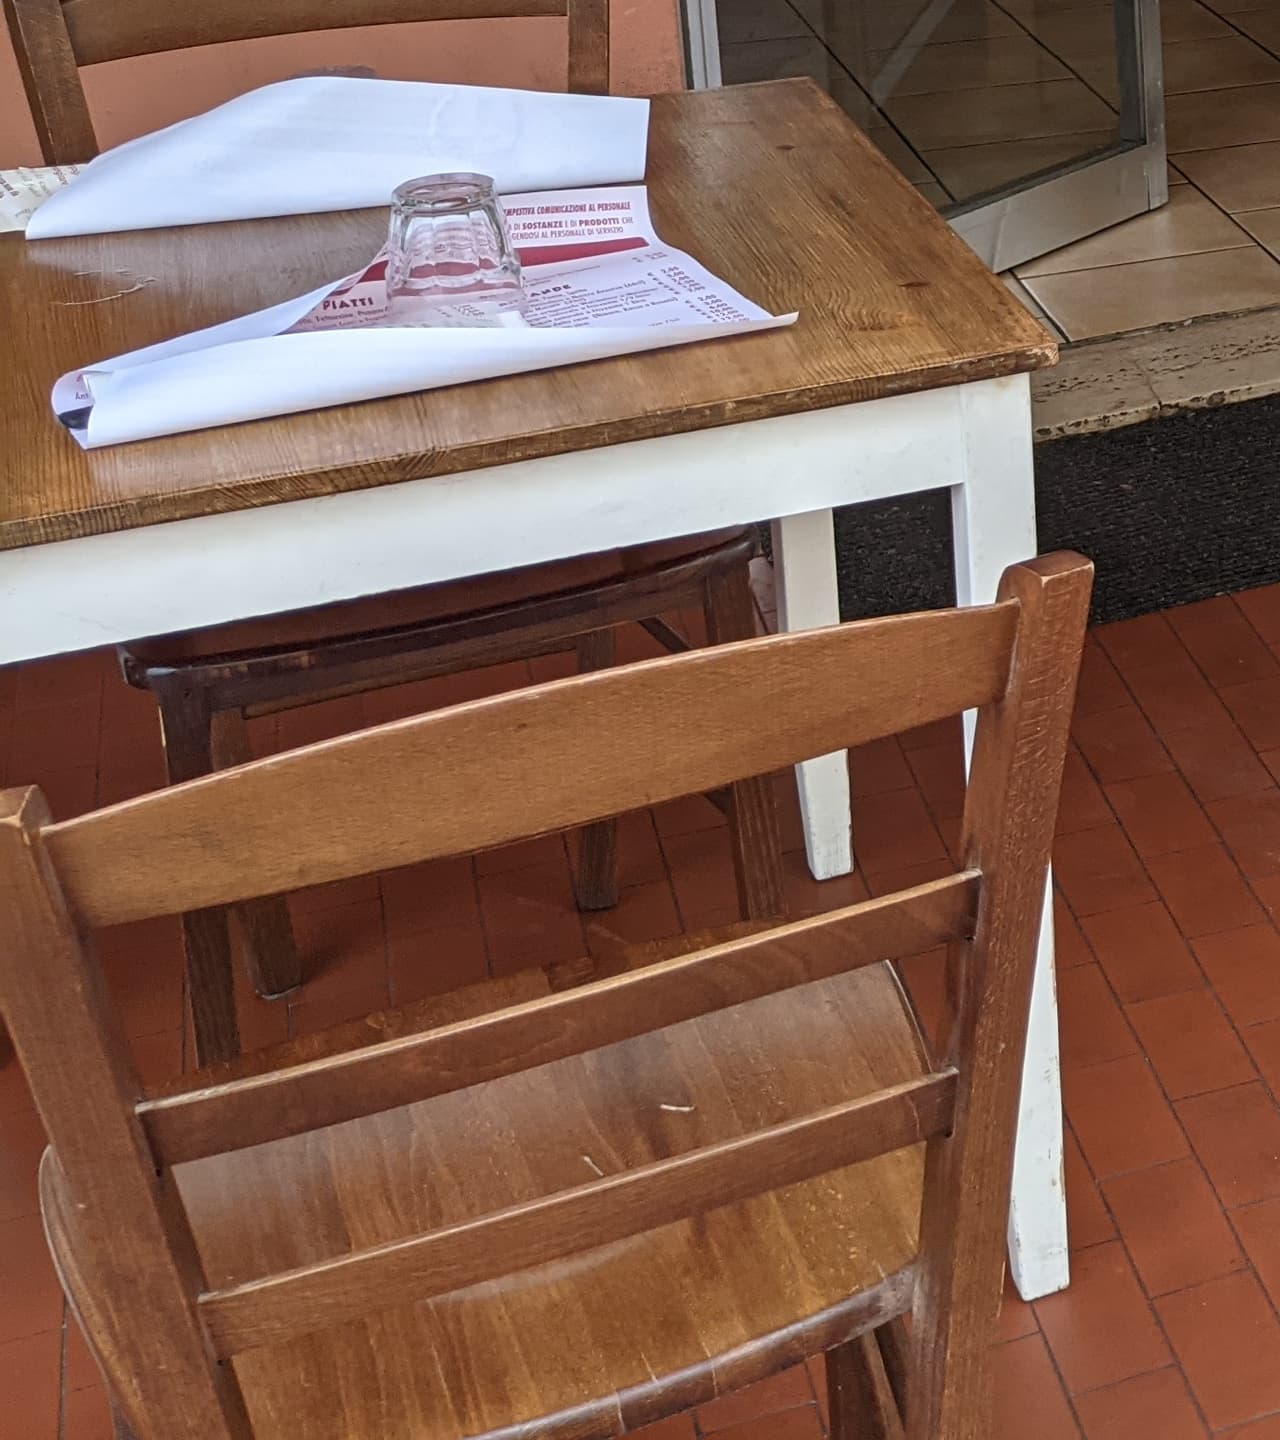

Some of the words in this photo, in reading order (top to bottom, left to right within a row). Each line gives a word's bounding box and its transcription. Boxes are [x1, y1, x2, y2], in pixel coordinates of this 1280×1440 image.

[537, 203, 587, 215] COMUNICAZIONE
[588, 203, 596, 212] AL
[597, 201, 631, 211] PERSONALE
[522, 221, 563, 230] SOSTANZE
[579, 217, 620, 227] PRODOTTI
[511, 232, 539, 241] GENDOSI
[550, 228, 585, 237] PERSONALE
[596, 226, 624, 234] SERVIZIO
[530, 284, 572, 297] ANDE
[323, 297, 374, 310] PIATTI
